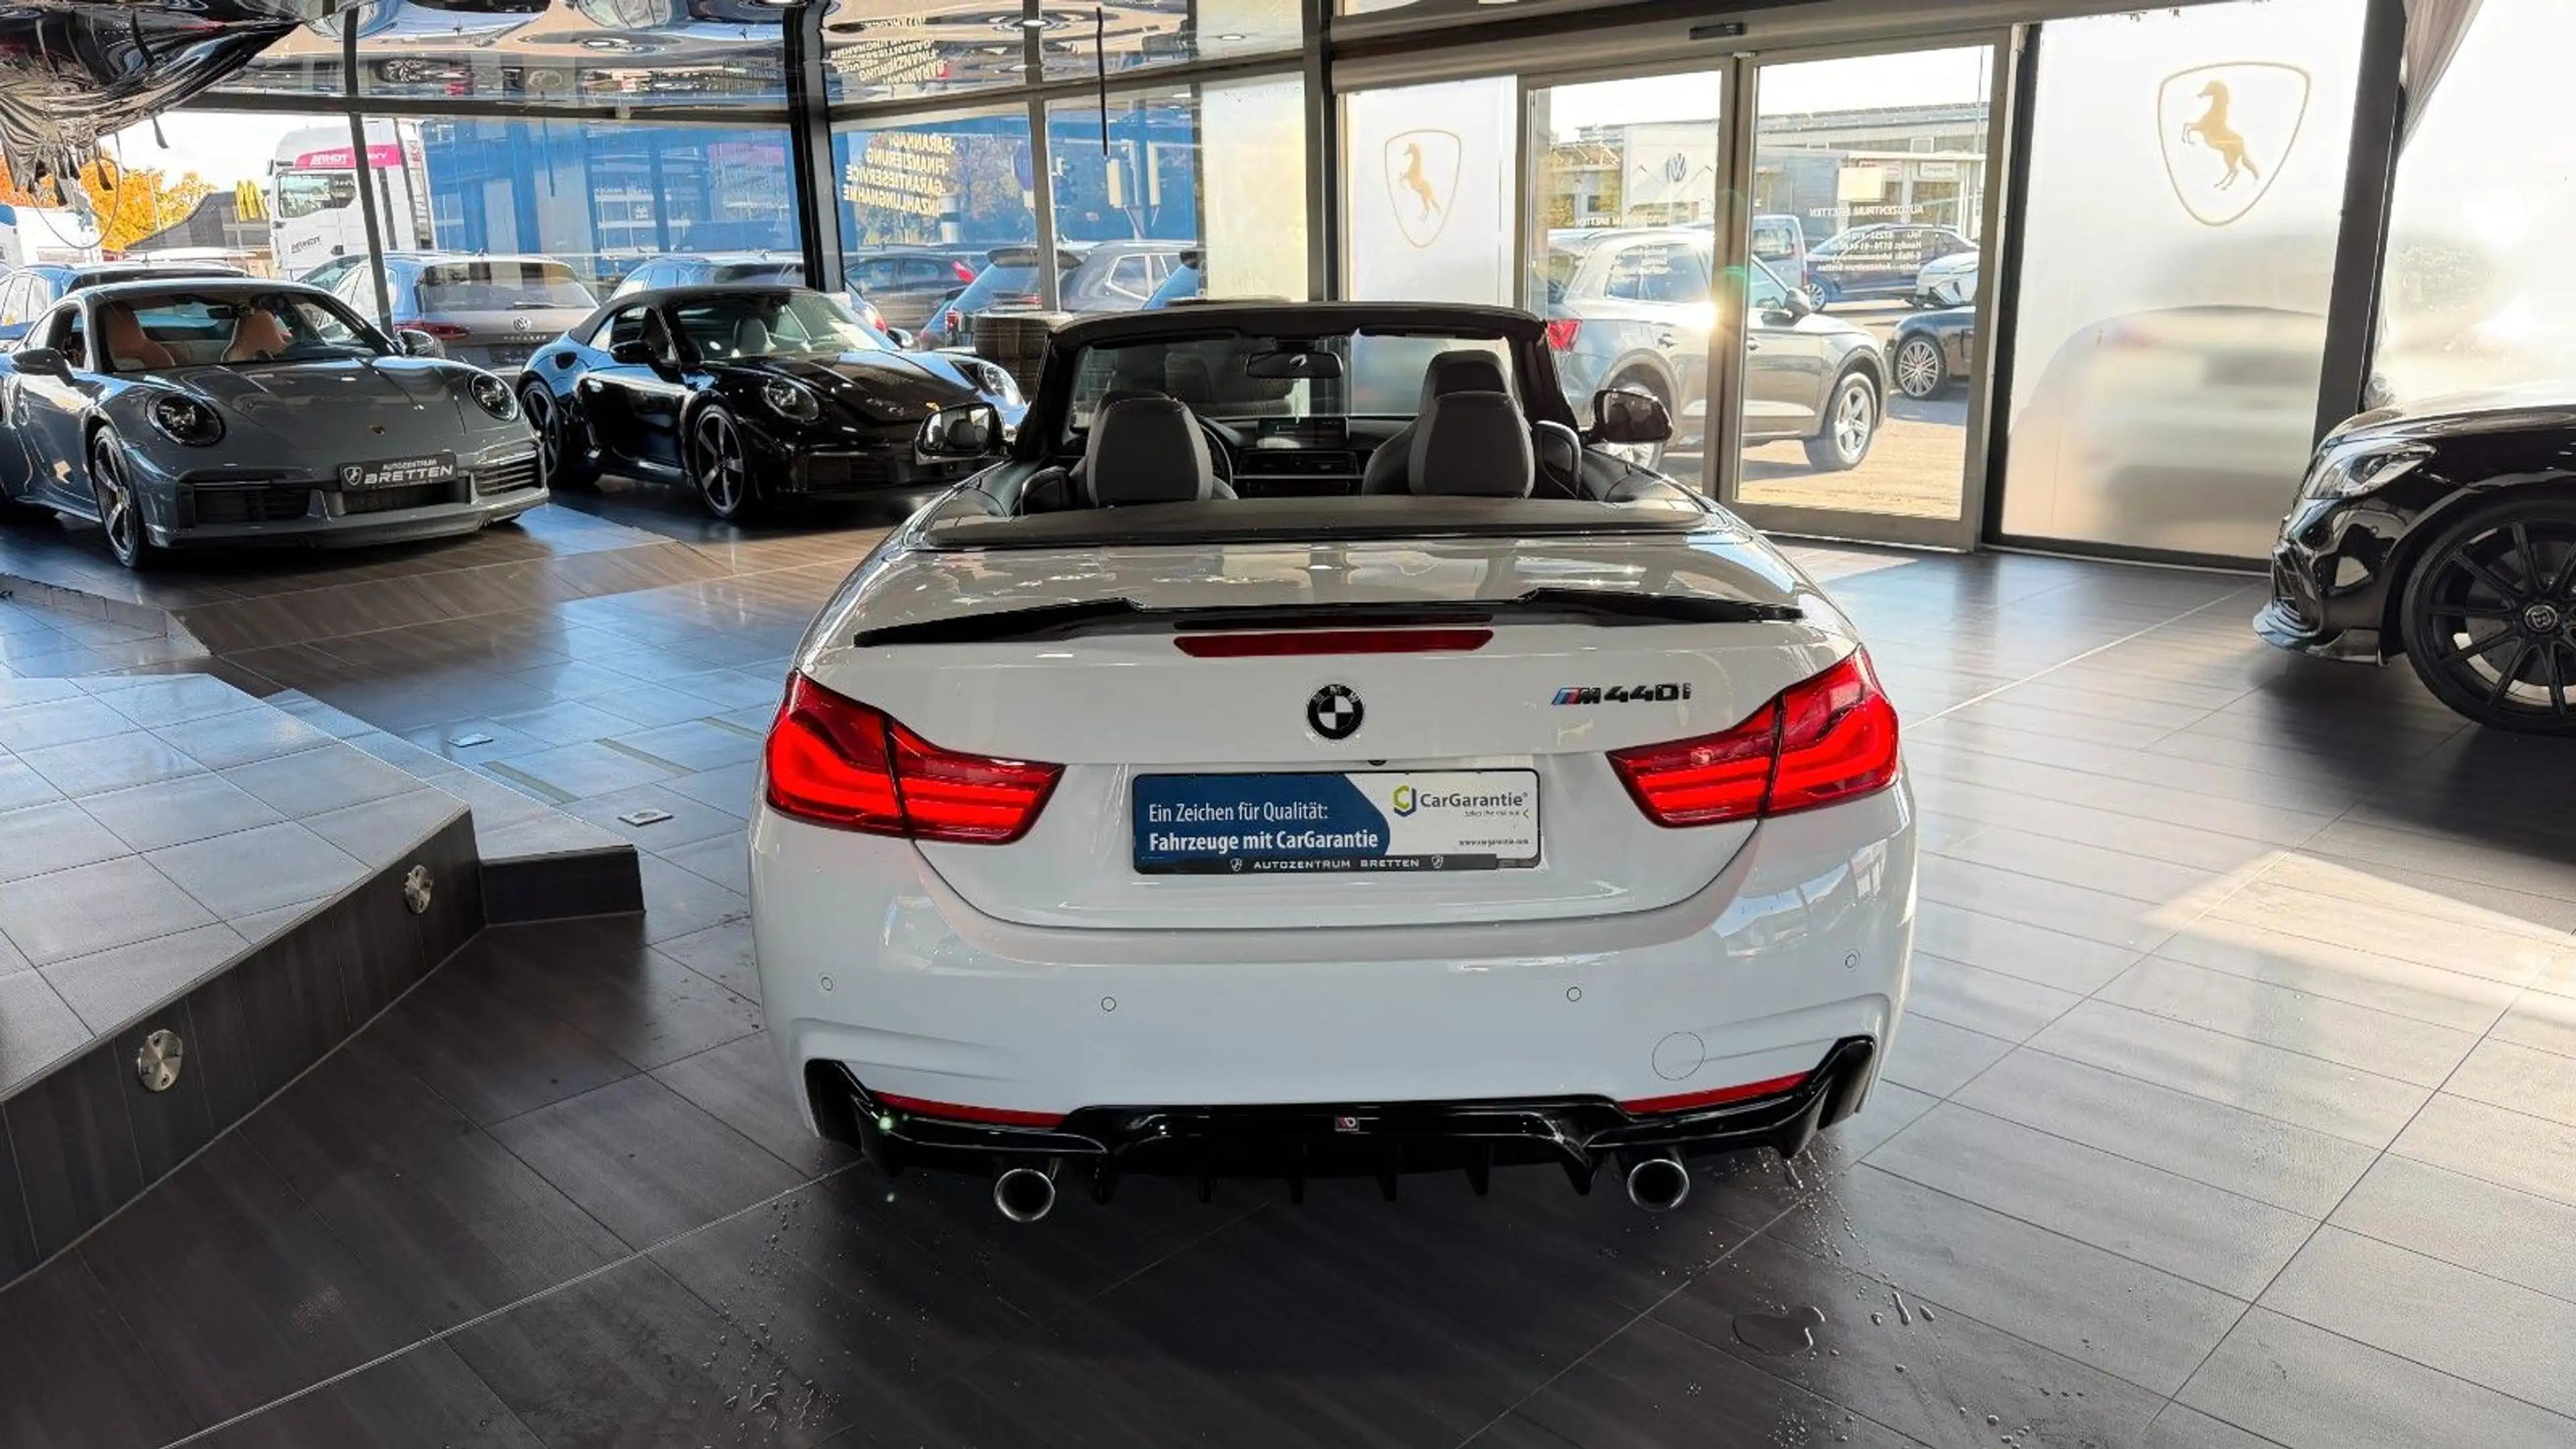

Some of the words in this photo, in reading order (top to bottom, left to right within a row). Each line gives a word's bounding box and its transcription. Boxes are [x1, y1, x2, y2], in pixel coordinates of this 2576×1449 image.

[364, 464, 453, 484] BRETTEN
[382, 459, 437, 470] AUTOZENTRUM
[1148, 804, 1172, 822] Ein
[1176, 802, 1234, 822] Zeichen
[1238, 802, 1260, 821] für
[1263, 800, 1328, 822] Qualität:
[1149, 833, 1239, 854] Fahrzeuge
[1242, 830, 1273, 849] mit
[1277, 829, 1379, 849] CarGarantie
[1253, 859, 1351, 870] AUTOZENTRUM
[1360, 859, 1419, 867] BRETTEN
